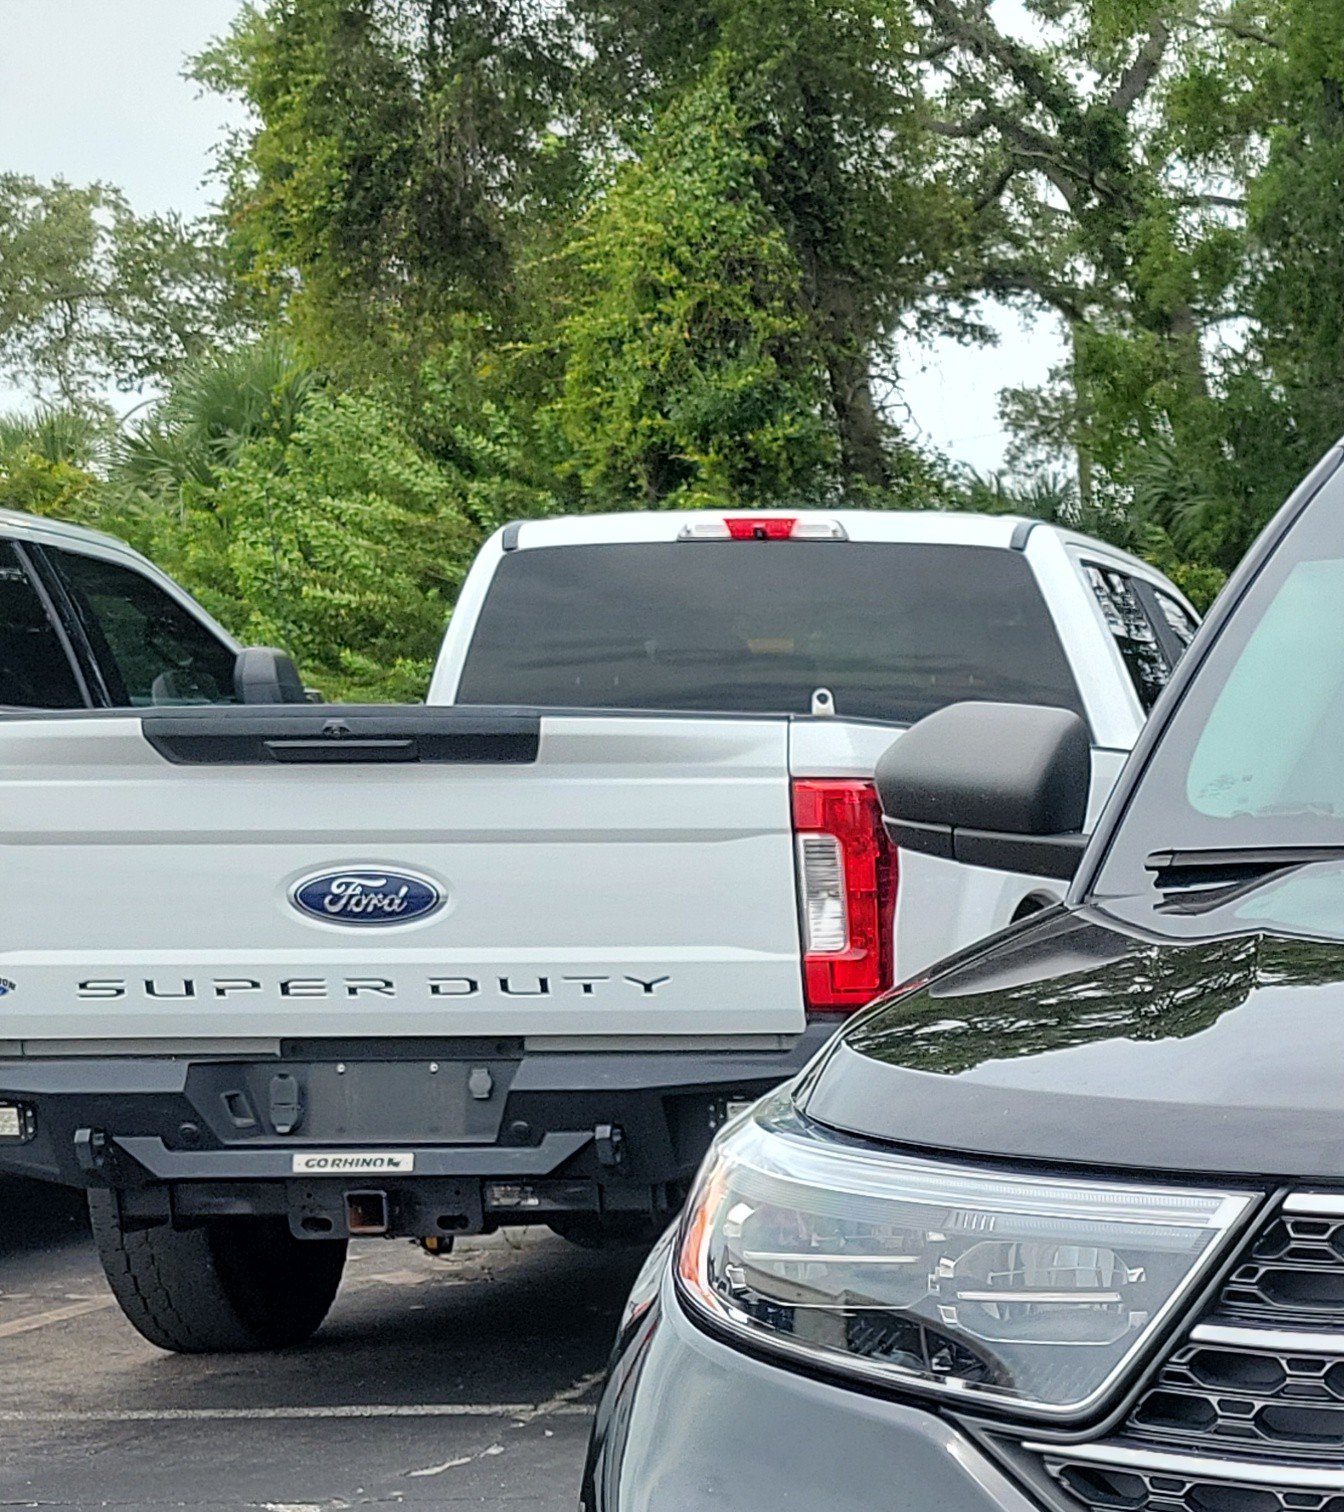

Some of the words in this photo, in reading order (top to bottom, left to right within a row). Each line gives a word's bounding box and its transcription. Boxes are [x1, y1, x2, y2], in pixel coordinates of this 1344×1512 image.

[323, 876, 410, 913] Ford
[78, 978, 396, 998] SUPER
[427, 975, 671, 995] DUTY
